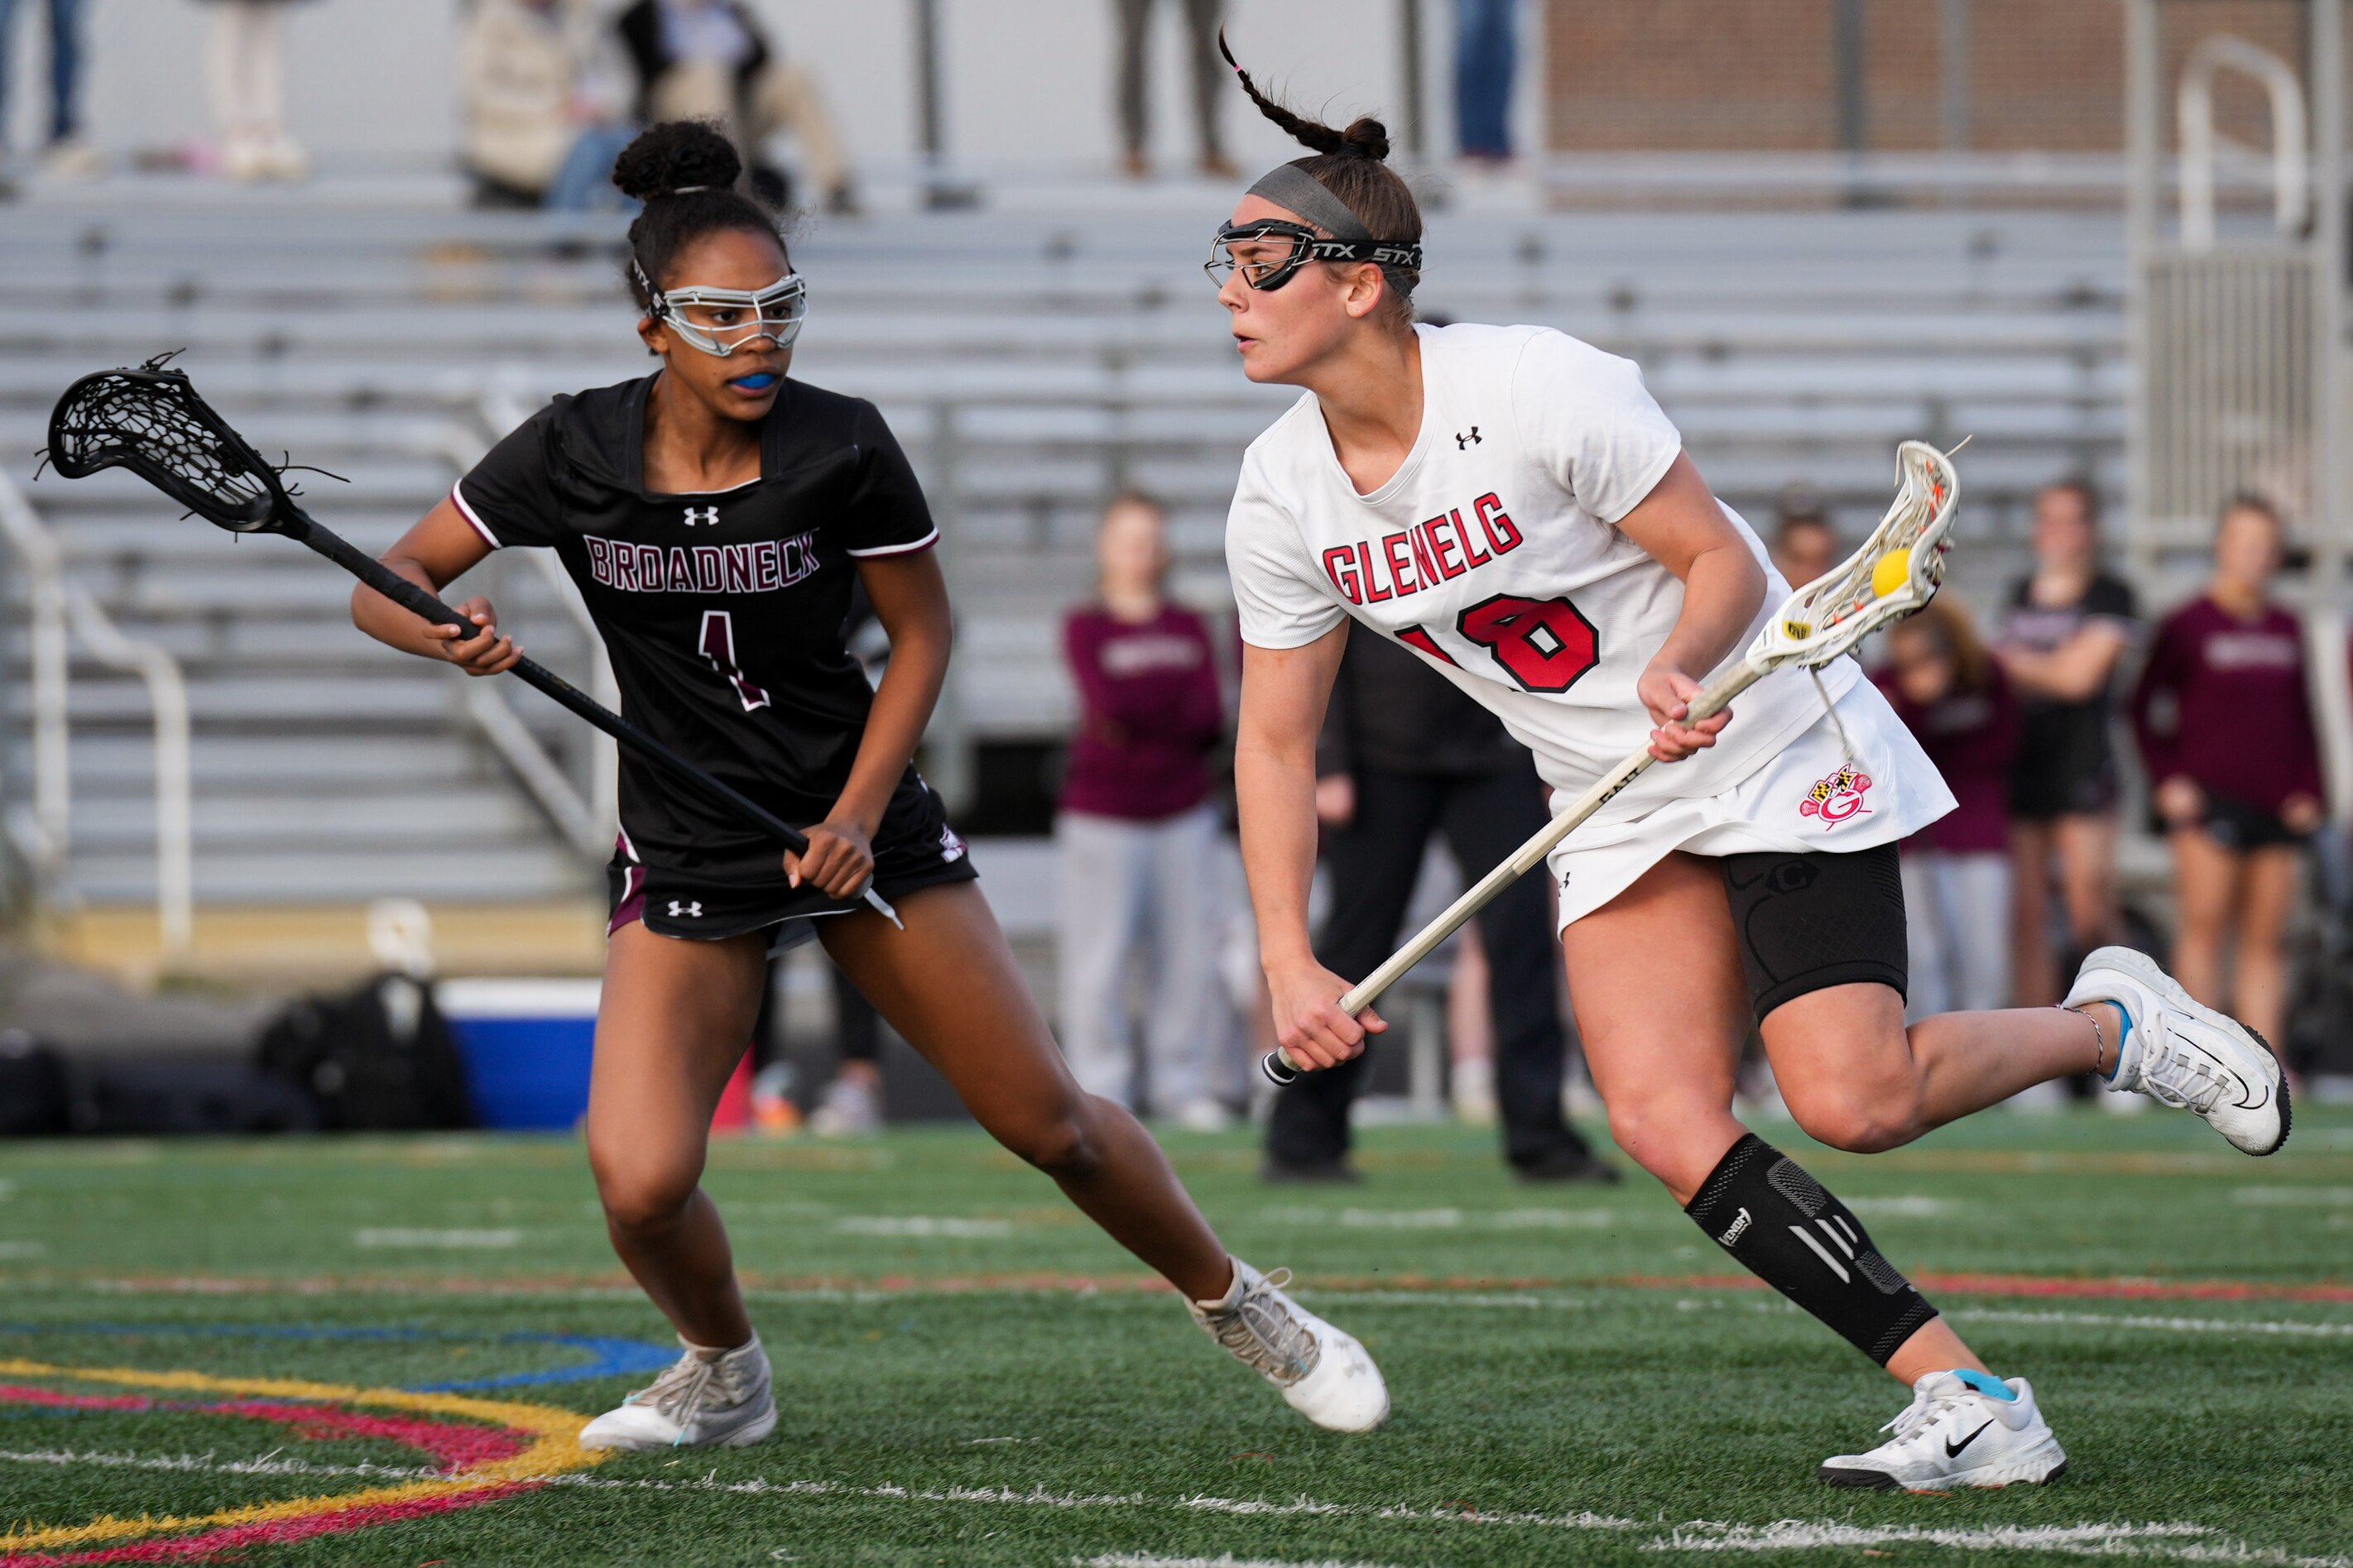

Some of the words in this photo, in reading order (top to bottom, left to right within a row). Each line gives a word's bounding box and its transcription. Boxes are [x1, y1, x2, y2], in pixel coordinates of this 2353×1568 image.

[1371, 247, 1415, 265] STX
[583, 527, 820, 593] BROADNECK
[1322, 491, 1524, 606] GLENELG
[699, 610, 771, 712] 1
